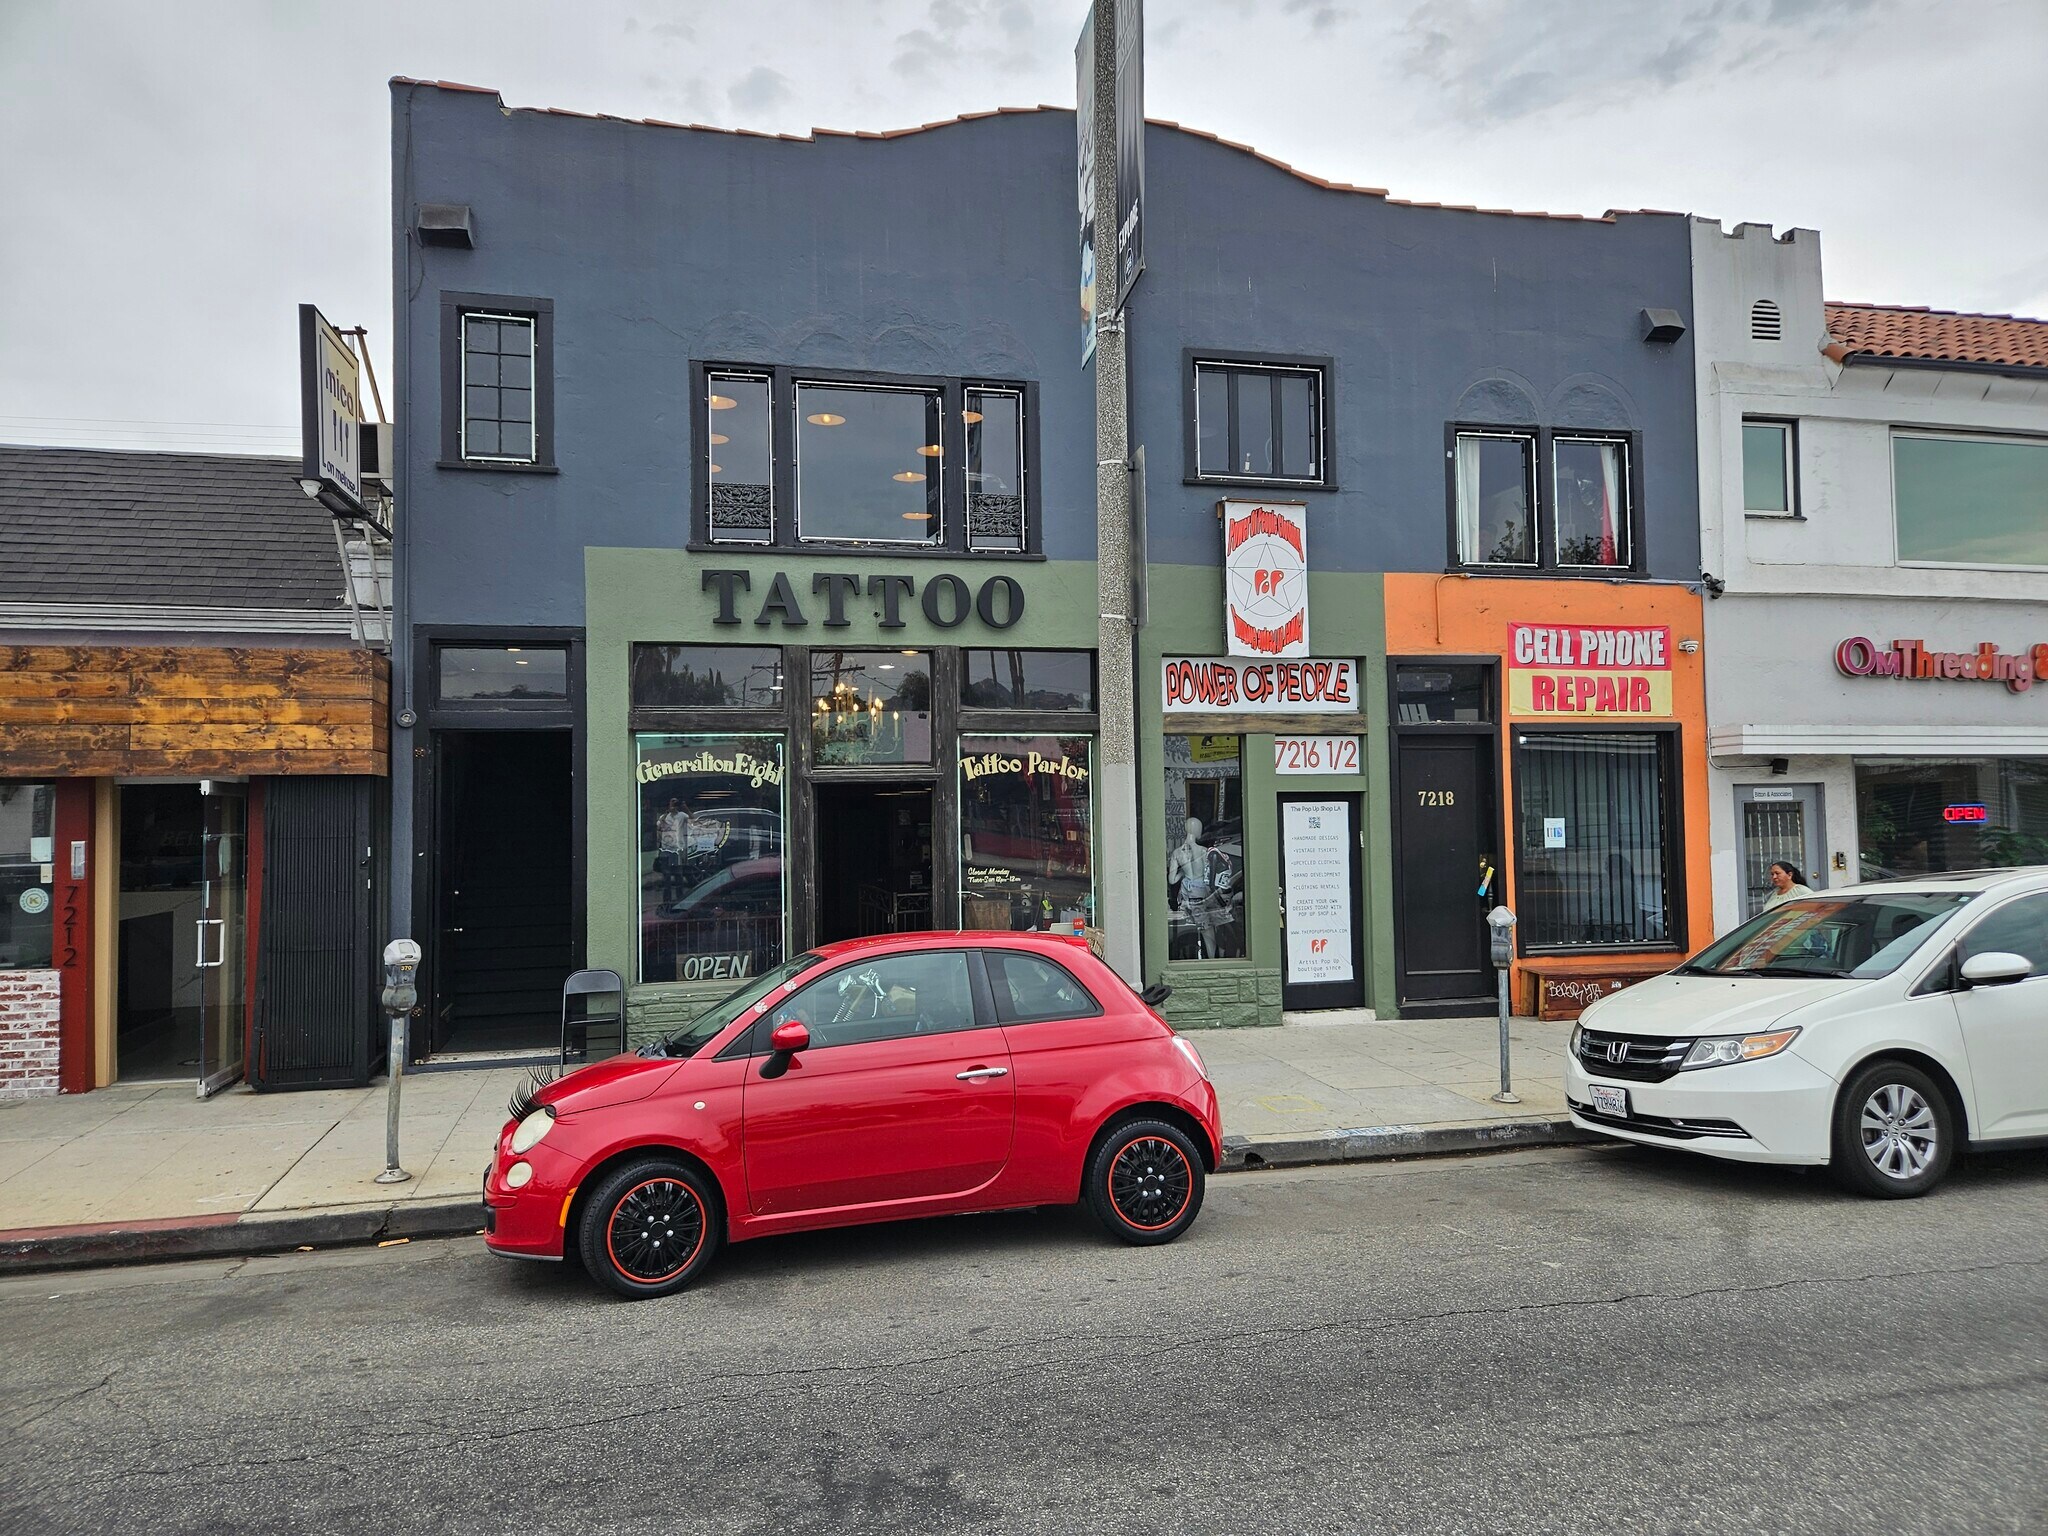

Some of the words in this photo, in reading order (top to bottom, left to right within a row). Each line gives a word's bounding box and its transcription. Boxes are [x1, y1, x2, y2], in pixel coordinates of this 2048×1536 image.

[325, 366, 354, 416] mica
[326, 461, 335, 475] on
[335, 465, 357, 496] melrose
[1227, 514, 1251, 556] Power
[701, 569, 1026, 629] TATTOO
[1515, 627, 1574, 664] CELL
[1580, 630, 1666, 666] PHONE
[1166, 660, 1239, 706] POWER
[1242, 664, 1274, 703] OF
[1276, 662, 1351, 703] PEOPLE
[1532, 675, 1652, 712] REPAIR
[958, 753, 1022, 781] Tattoo
[1028, 751, 1089, 780] Parlor
[1275, 740, 1320, 768] 7216
[1326, 740, 1357, 770] 1/2
[1418, 791, 1454, 806] 7218
[1944, 807, 1985, 820] OPEN
[968, 867, 988, 875] Closed
[988, 867, 1010, 878] Monday
[63, 885, 78, 967] 7212
[684, 955, 749, 980] OPEN
